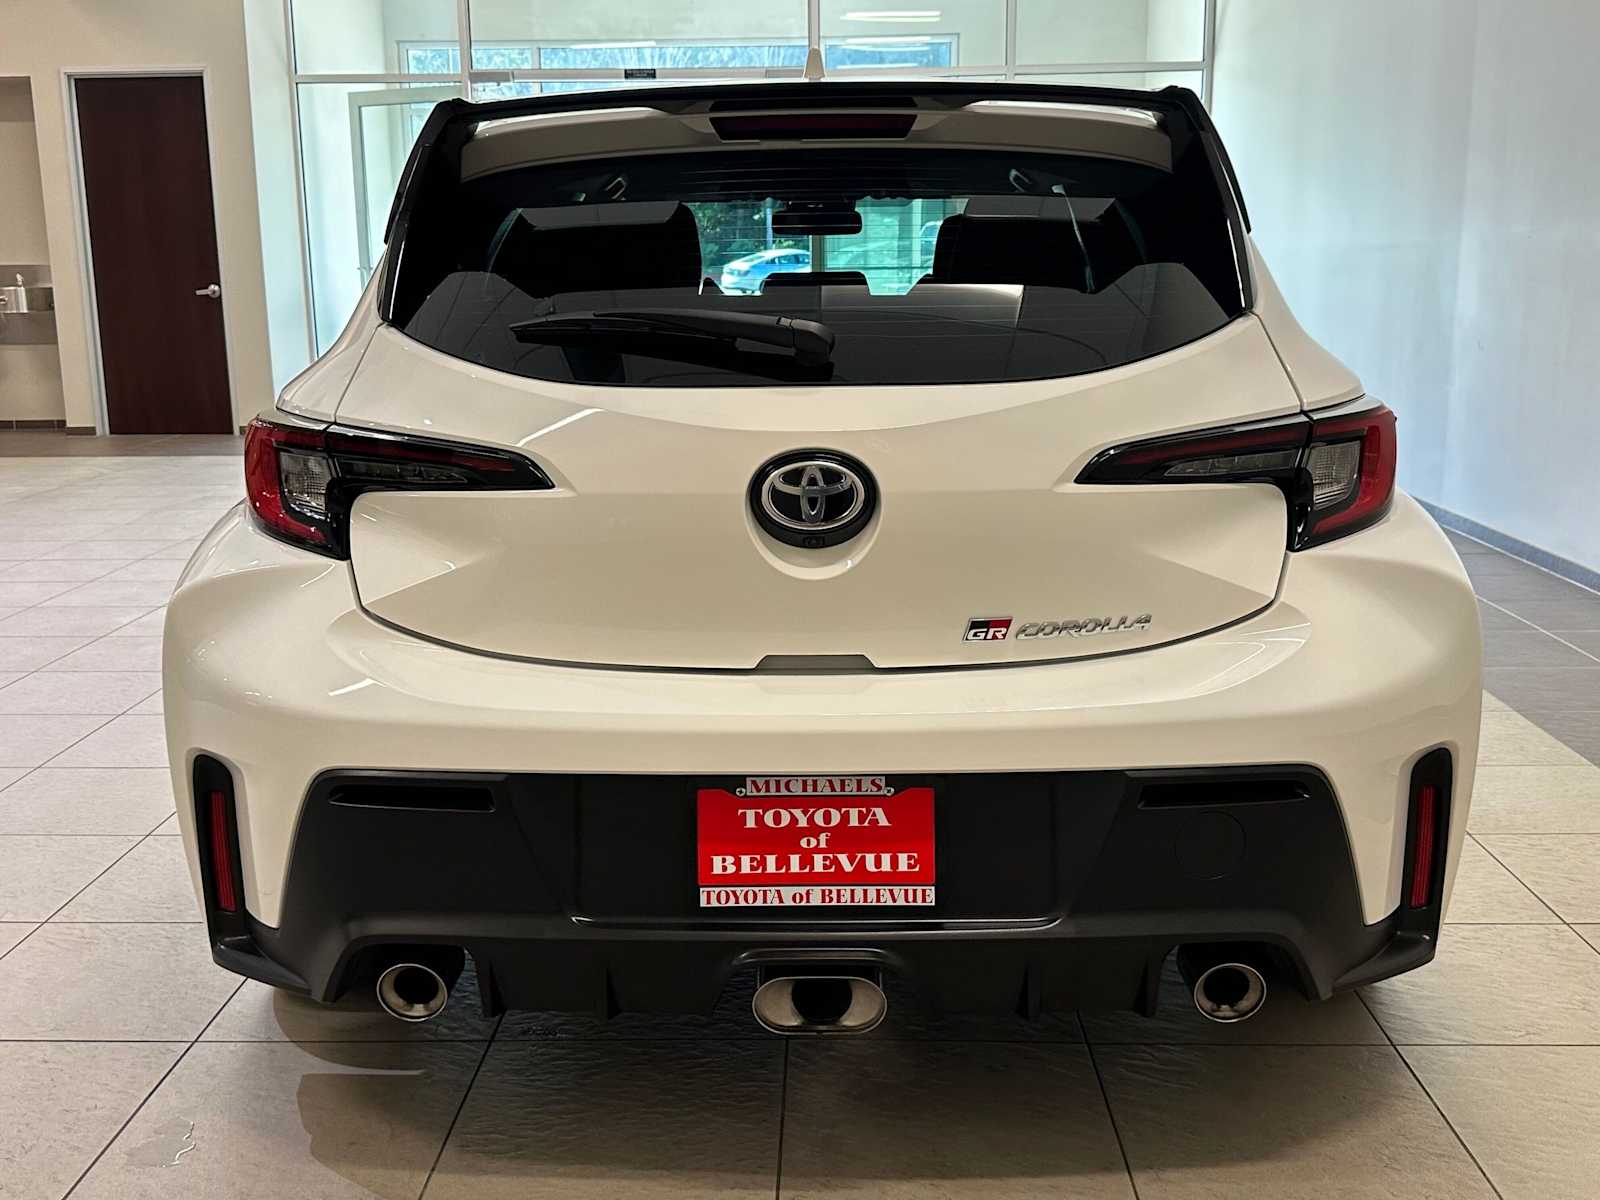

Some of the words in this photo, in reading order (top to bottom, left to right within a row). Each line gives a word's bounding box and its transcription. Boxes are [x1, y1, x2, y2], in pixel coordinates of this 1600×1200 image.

[967, 627, 1008, 641] GR
[1016, 614, 1152, 640] COROLLA
[749, 778, 884, 794] MICHAELS
[737, 807, 892, 828] TOYOTA
[799, 832, 831, 849] of
[710, 852, 920, 875] BELLEVUE
[701, 889, 784, 905] TOYOTA
[791, 889, 813, 905] of
[820, 888, 934, 904] BELLEVUE
